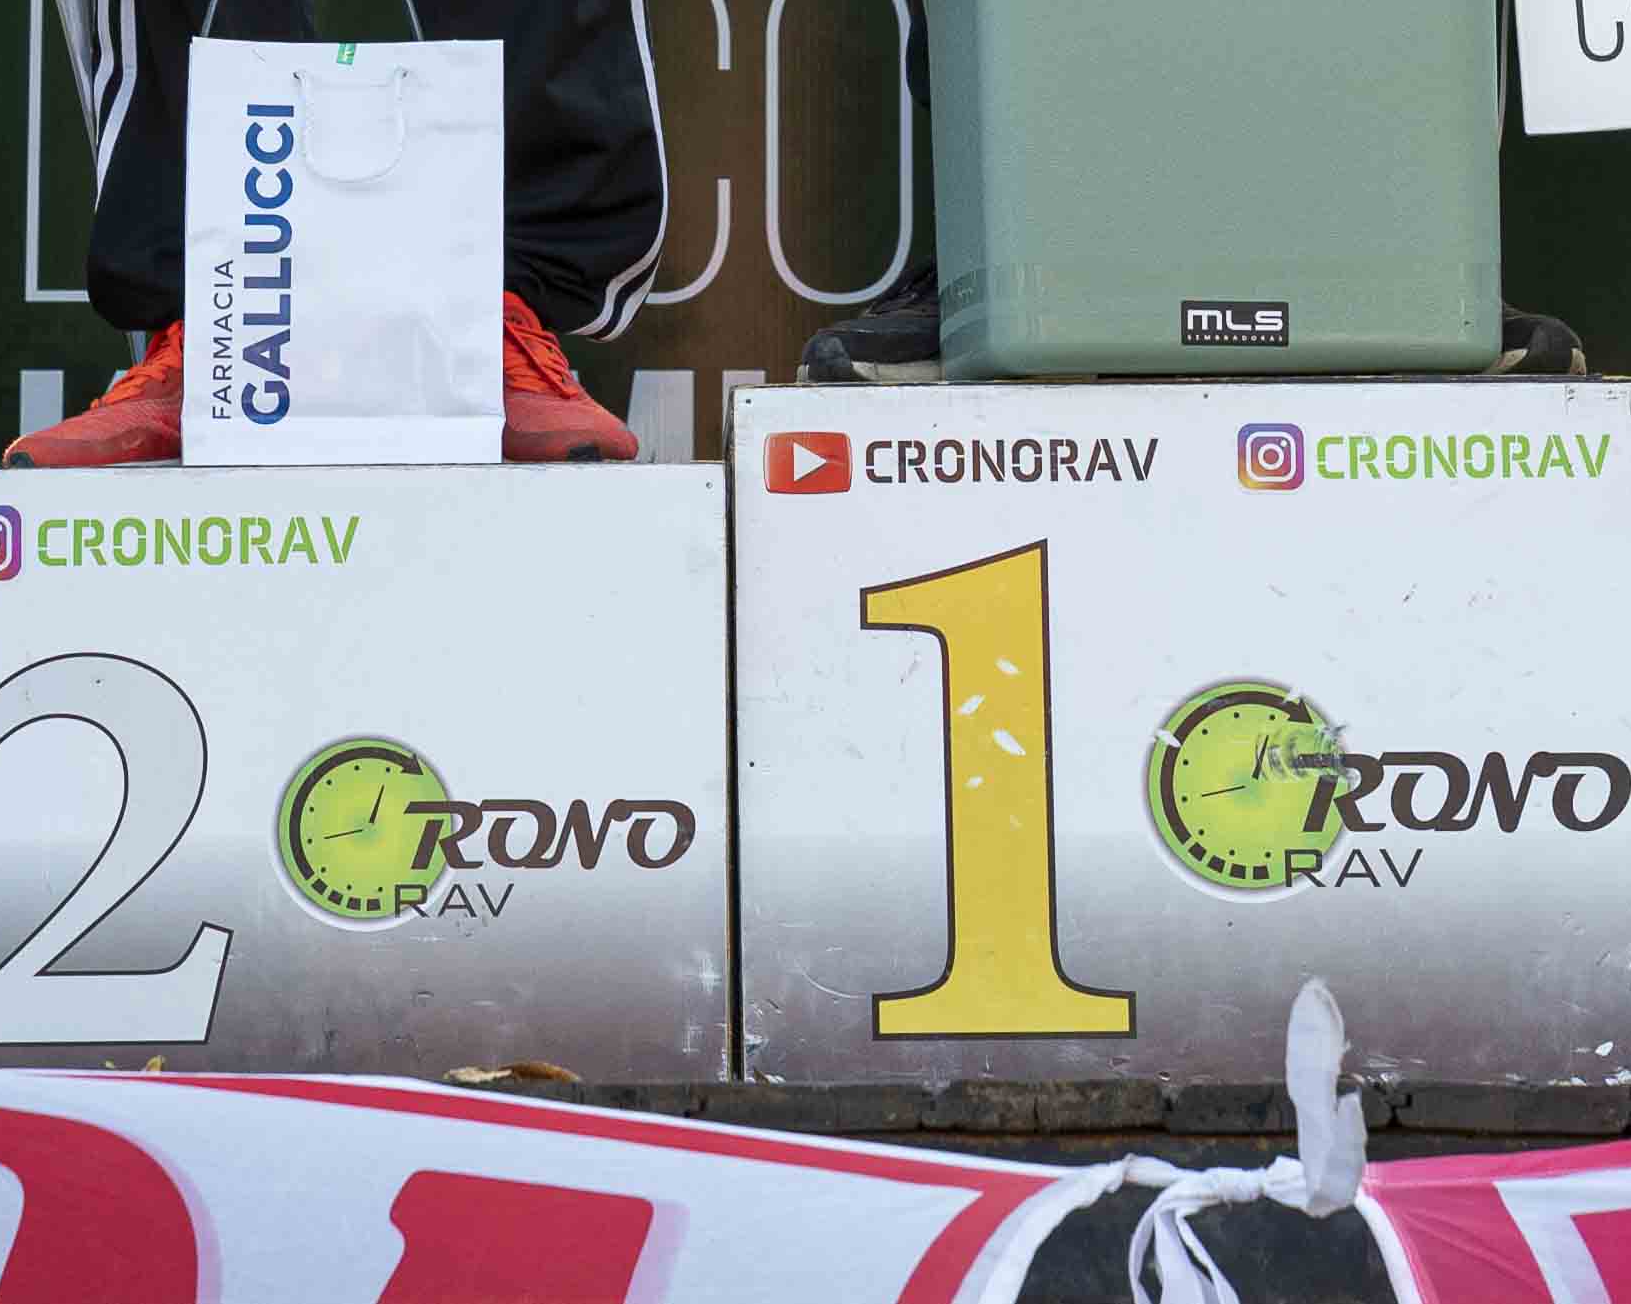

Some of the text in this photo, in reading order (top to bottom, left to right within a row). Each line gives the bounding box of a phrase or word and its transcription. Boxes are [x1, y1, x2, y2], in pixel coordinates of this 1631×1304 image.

[240, 102, 296, 426] GALLUCCI
[210, 257, 236, 421] FARMACIA
[864, 437, 1158, 485] CRONORAV
[1316, 433, 1611, 482] CRONORAV
[36, 515, 360, 567] CRONORAV
[860, 537, 1137, 1041] 1
[1284, 847, 1423, 889] RAV
[393, 882, 515, 919] RAV
